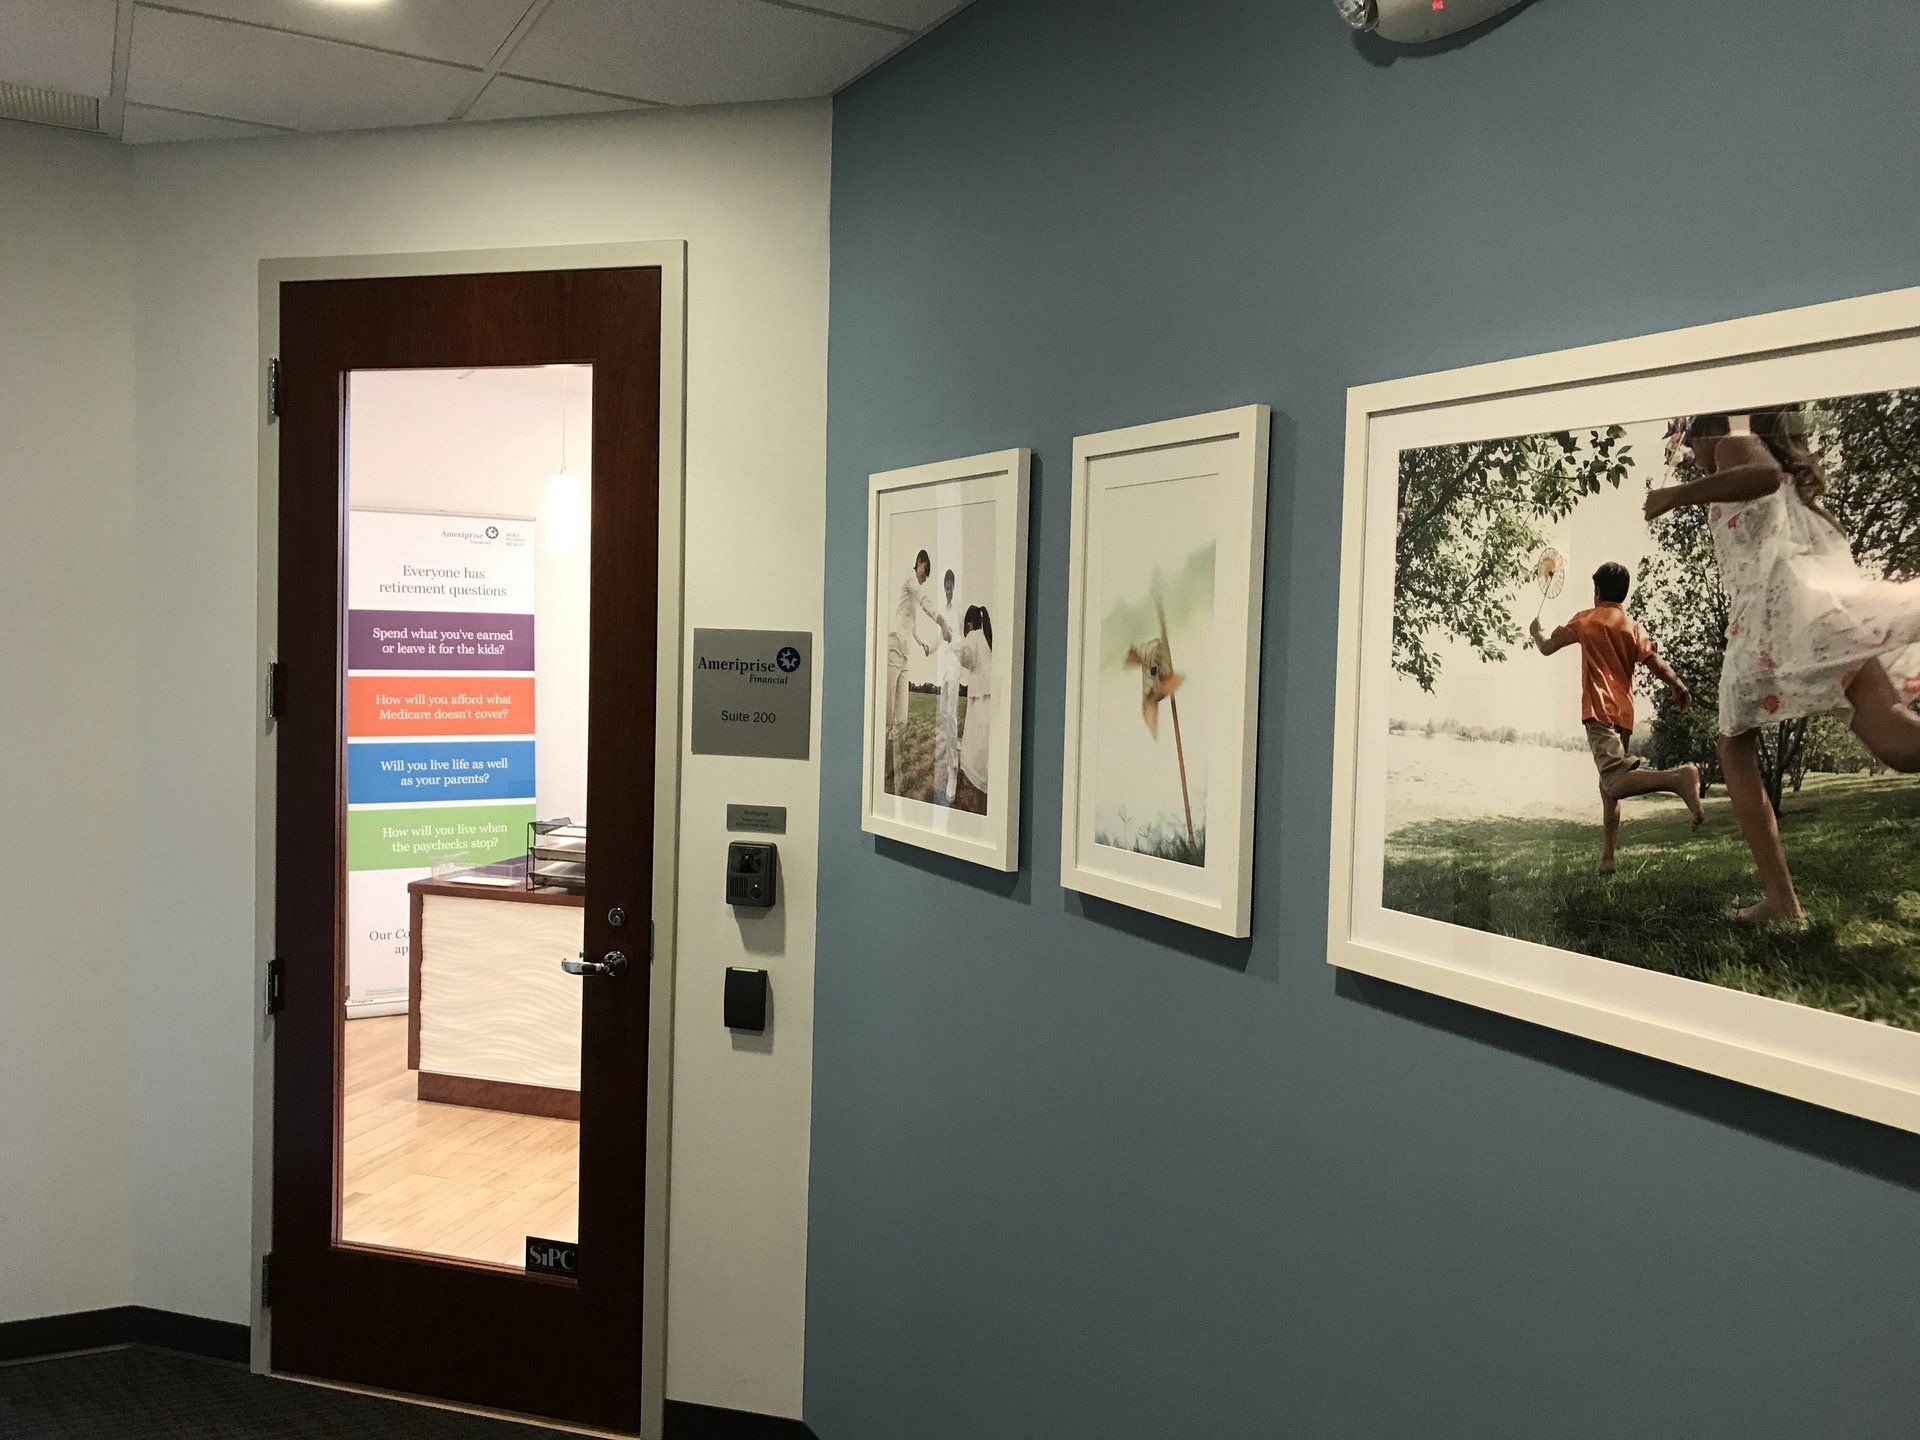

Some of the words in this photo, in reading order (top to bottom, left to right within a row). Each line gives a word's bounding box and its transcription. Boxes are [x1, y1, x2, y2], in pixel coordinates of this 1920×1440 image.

[440, 530, 484, 540] Ameriprise
[403, 565, 460, 580] Everyone
[464, 567, 485, 579] has
[379, 582, 445, 595] retirement
[449, 585, 507, 598] questions
[372, 628, 408, 641] Spend
[411, 629, 438, 639] what
[440, 629, 474, 641] you've
[476, 630, 513, 641] earned
[382, 645, 395, 654] or
[397, 643, 425, 654] leave
[428, 643, 436, 654] it
[438, 643, 454, 654] for
[457, 644, 475, 654] the
[477, 644, 505, 655] kids?
[697, 657, 776, 675] Ameriprise
[749, 674, 788, 685] Financial
[375, 694, 402, 705] How
[405, 694, 426, 704] will
[428, 697, 448, 707] you
[451, 694, 483, 705] afford
[486, 695, 511, 704] what
[379, 709, 431, 720] Medicare
[434, 709, 472, 719] doesn't
[475, 708, 509, 719] cover?
[721, 710, 750, 722] Suite
[753, 712, 776, 723] 200
[381, 760, 404, 771] Will
[407, 762, 427, 773] you
[430, 759, 449, 770] live
[452, 759, 469, 770] life
[472, 761, 484, 769] as
[487, 758, 508, 769] well
[400, 777, 413, 786] as
[416, 776, 441, 788] your
[444, 773, 489, 787] parents?
[383, 827, 408, 838] How
[411, 826, 432, 837] will
[435, 827, 454, 838] you
[457, 824, 476, 835] live
[479, 823, 508, 834] when
[392, 842, 410, 852] the
[413, 838, 468, 854] paychecks
[471, 837, 499, 850] stop?
[369, 930, 393, 941] Our
